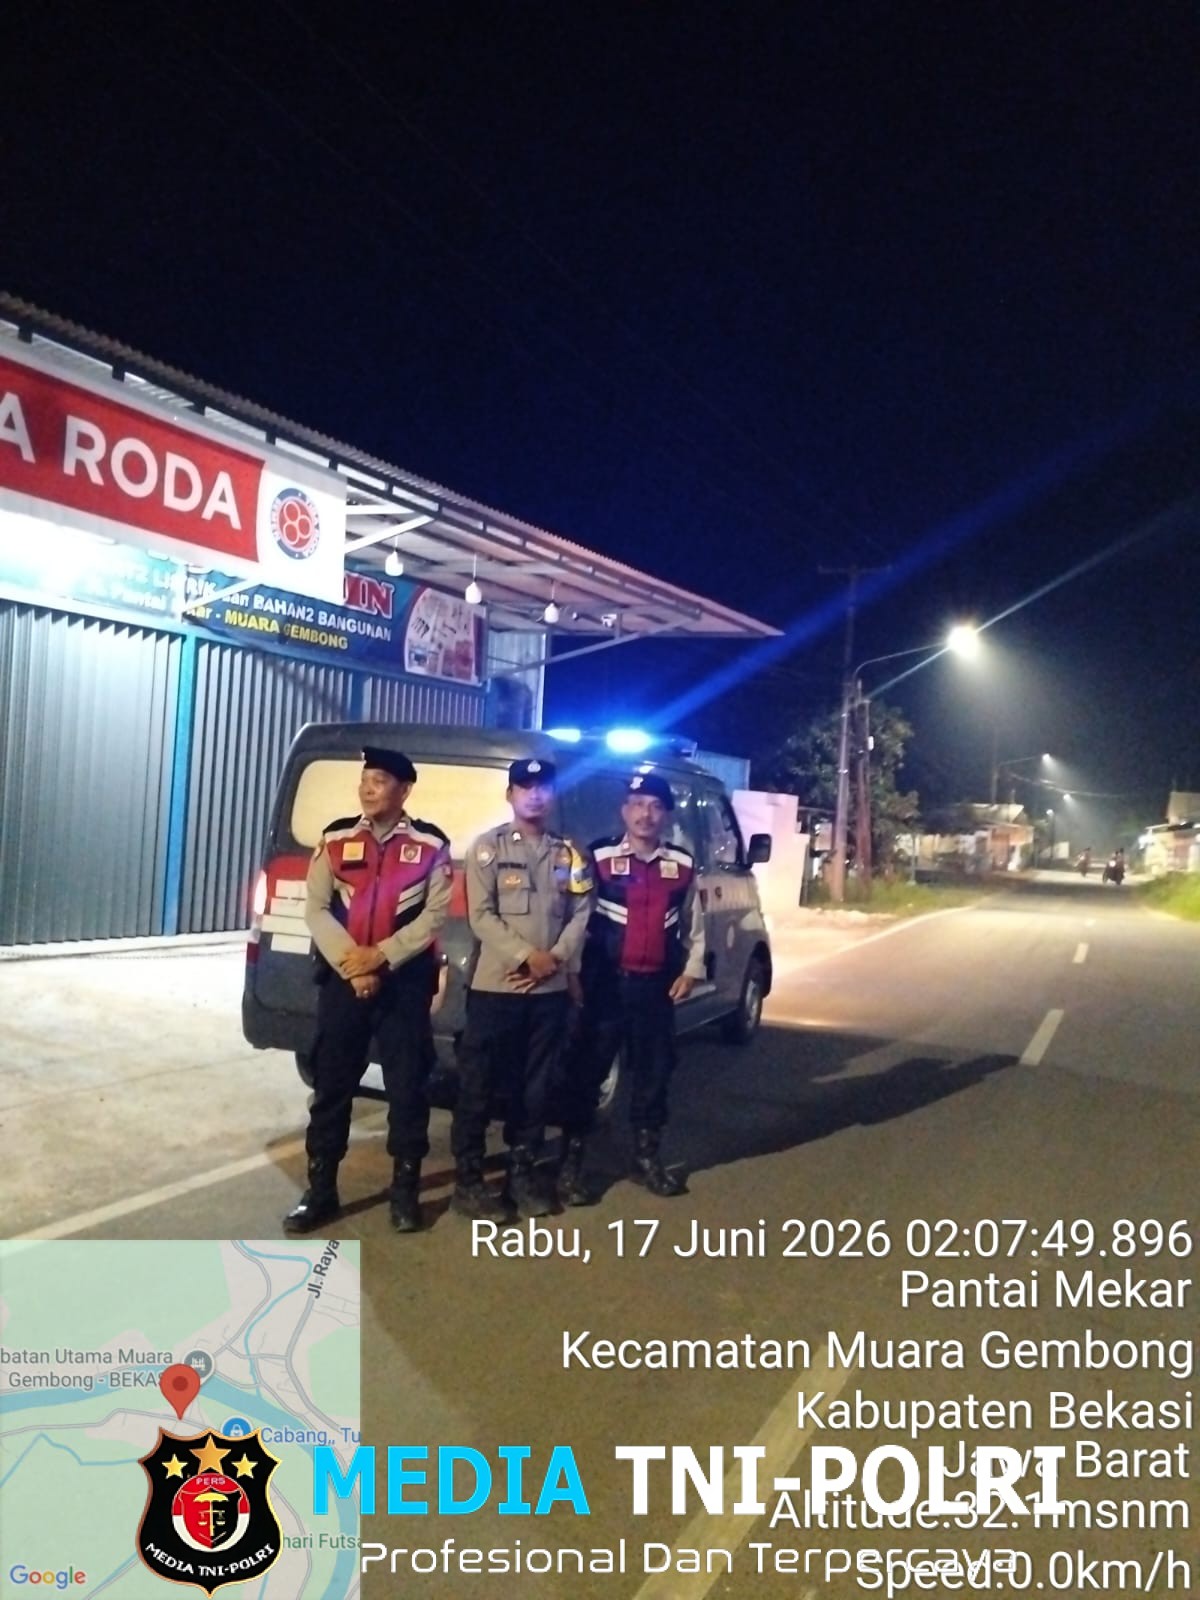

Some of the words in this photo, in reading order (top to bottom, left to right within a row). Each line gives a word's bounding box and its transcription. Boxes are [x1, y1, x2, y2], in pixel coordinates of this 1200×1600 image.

[63, 415, 242, 530] RODA
[224, 608, 280, 634] MUARA
[283, 623, 348, 650] GEMBONG
[253, 594, 314, 622] BAHAN2
[317, 610, 392, 642] BANGUNAN
